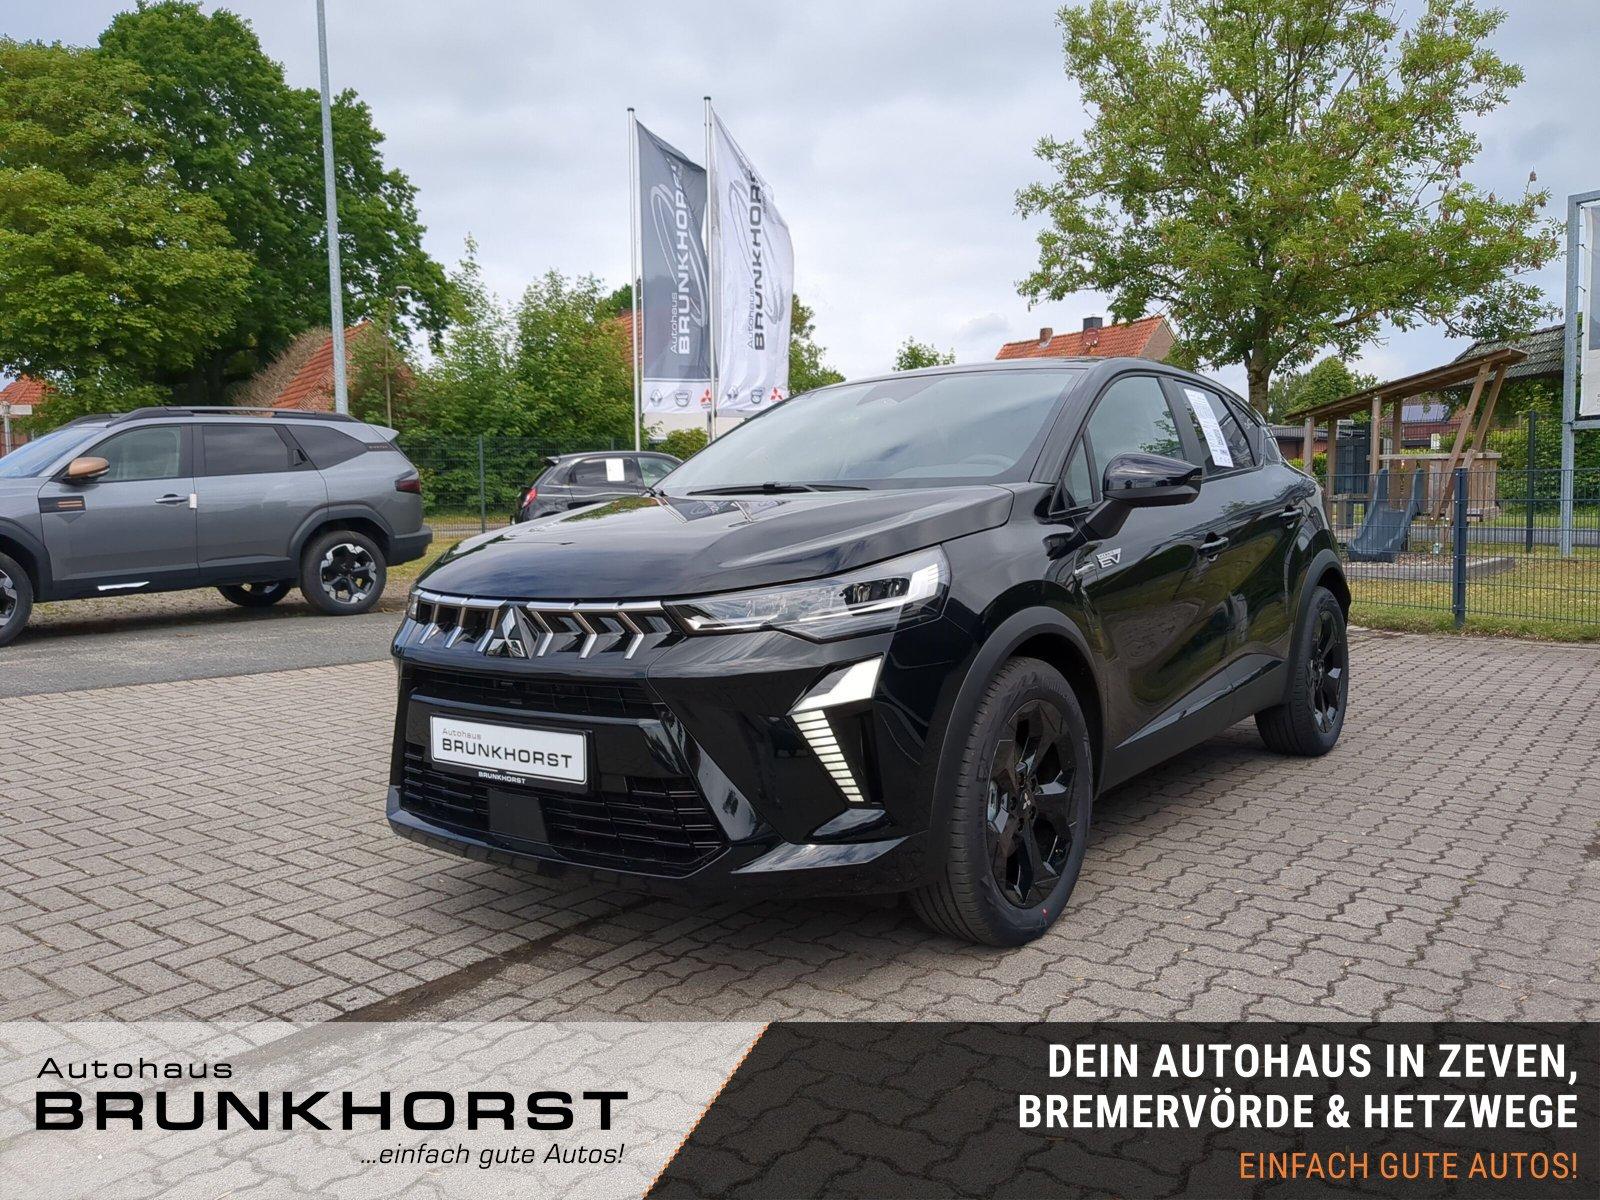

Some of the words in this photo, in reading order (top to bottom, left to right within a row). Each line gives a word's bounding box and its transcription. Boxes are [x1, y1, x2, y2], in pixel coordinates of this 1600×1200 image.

[670, 292, 679, 354] Autohaus
[747, 287, 755, 349] Autohaus
[442, 728, 482, 740] Autohaus
[442, 738, 573, 769] BRUNKHORST
[478, 771, 526, 784] BRUNKHORST
